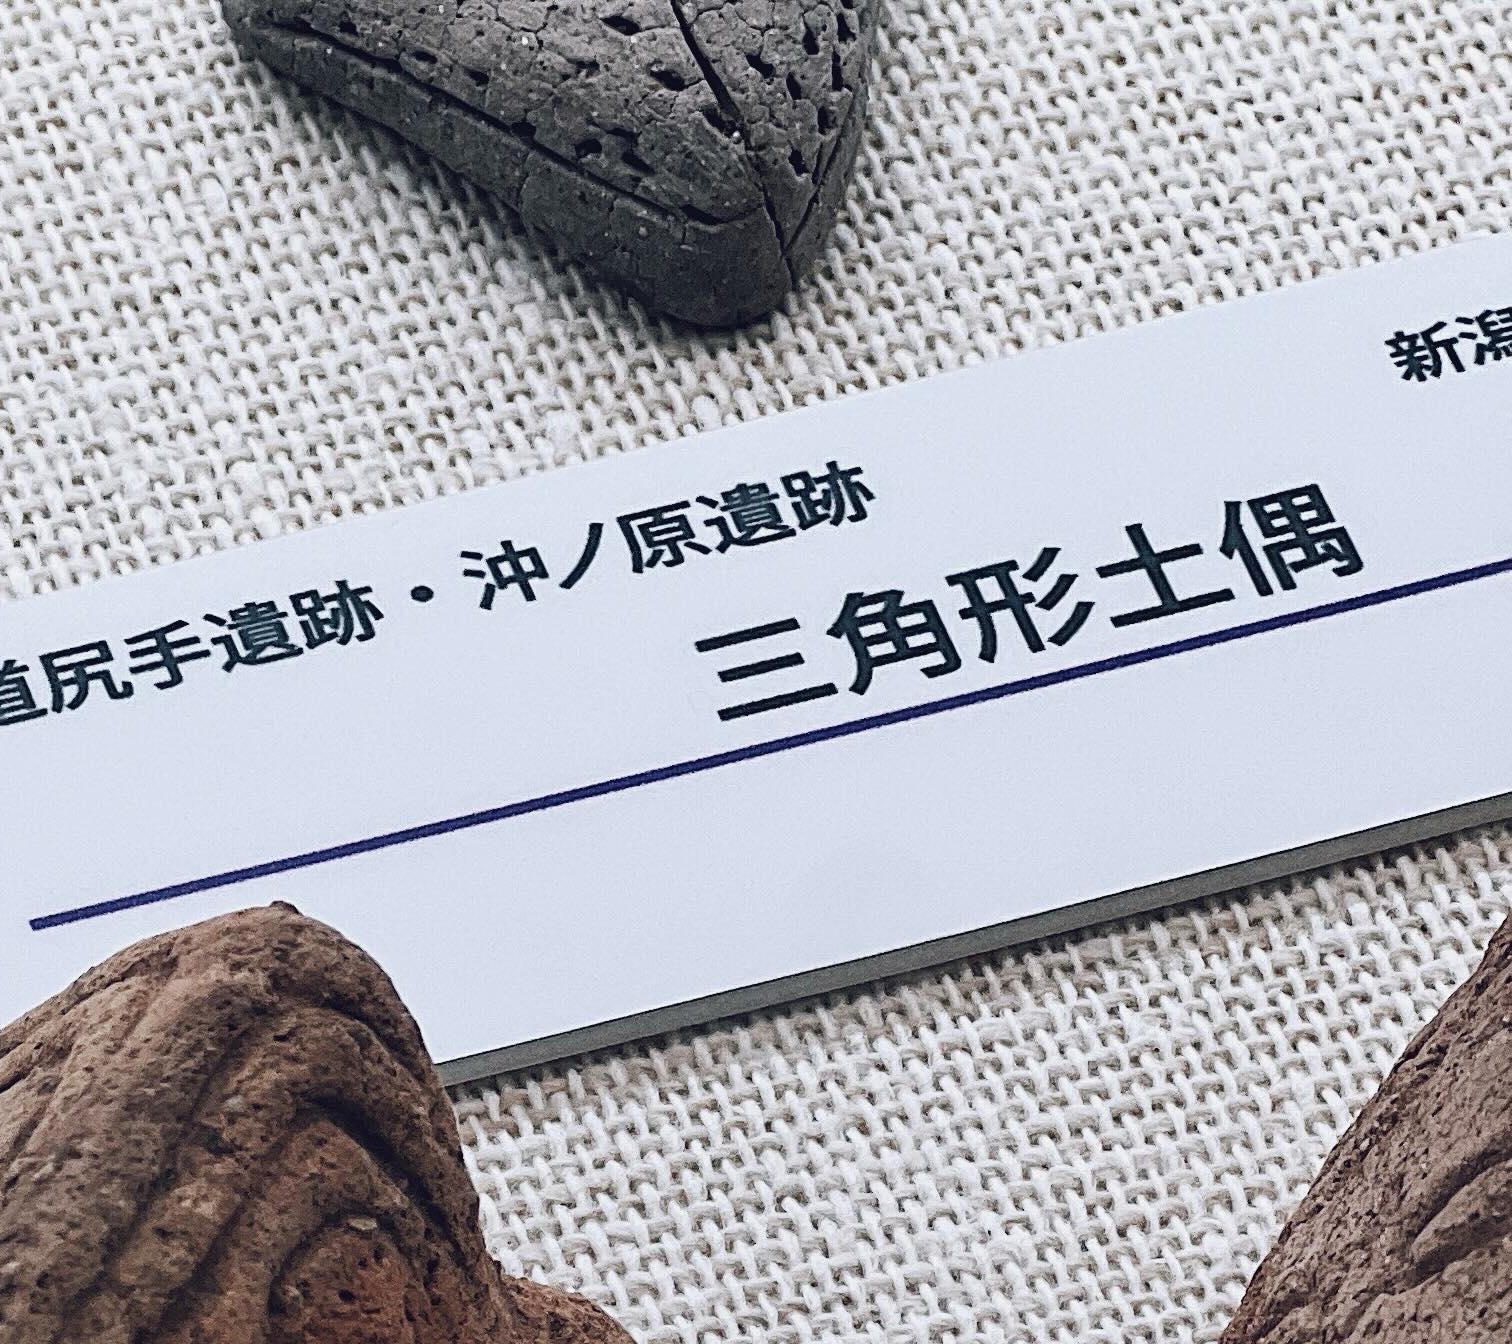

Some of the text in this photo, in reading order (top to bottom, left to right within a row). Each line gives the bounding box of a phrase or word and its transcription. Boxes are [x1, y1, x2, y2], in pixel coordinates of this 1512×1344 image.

[694, 483, 1365, 721] 三角形土偶
